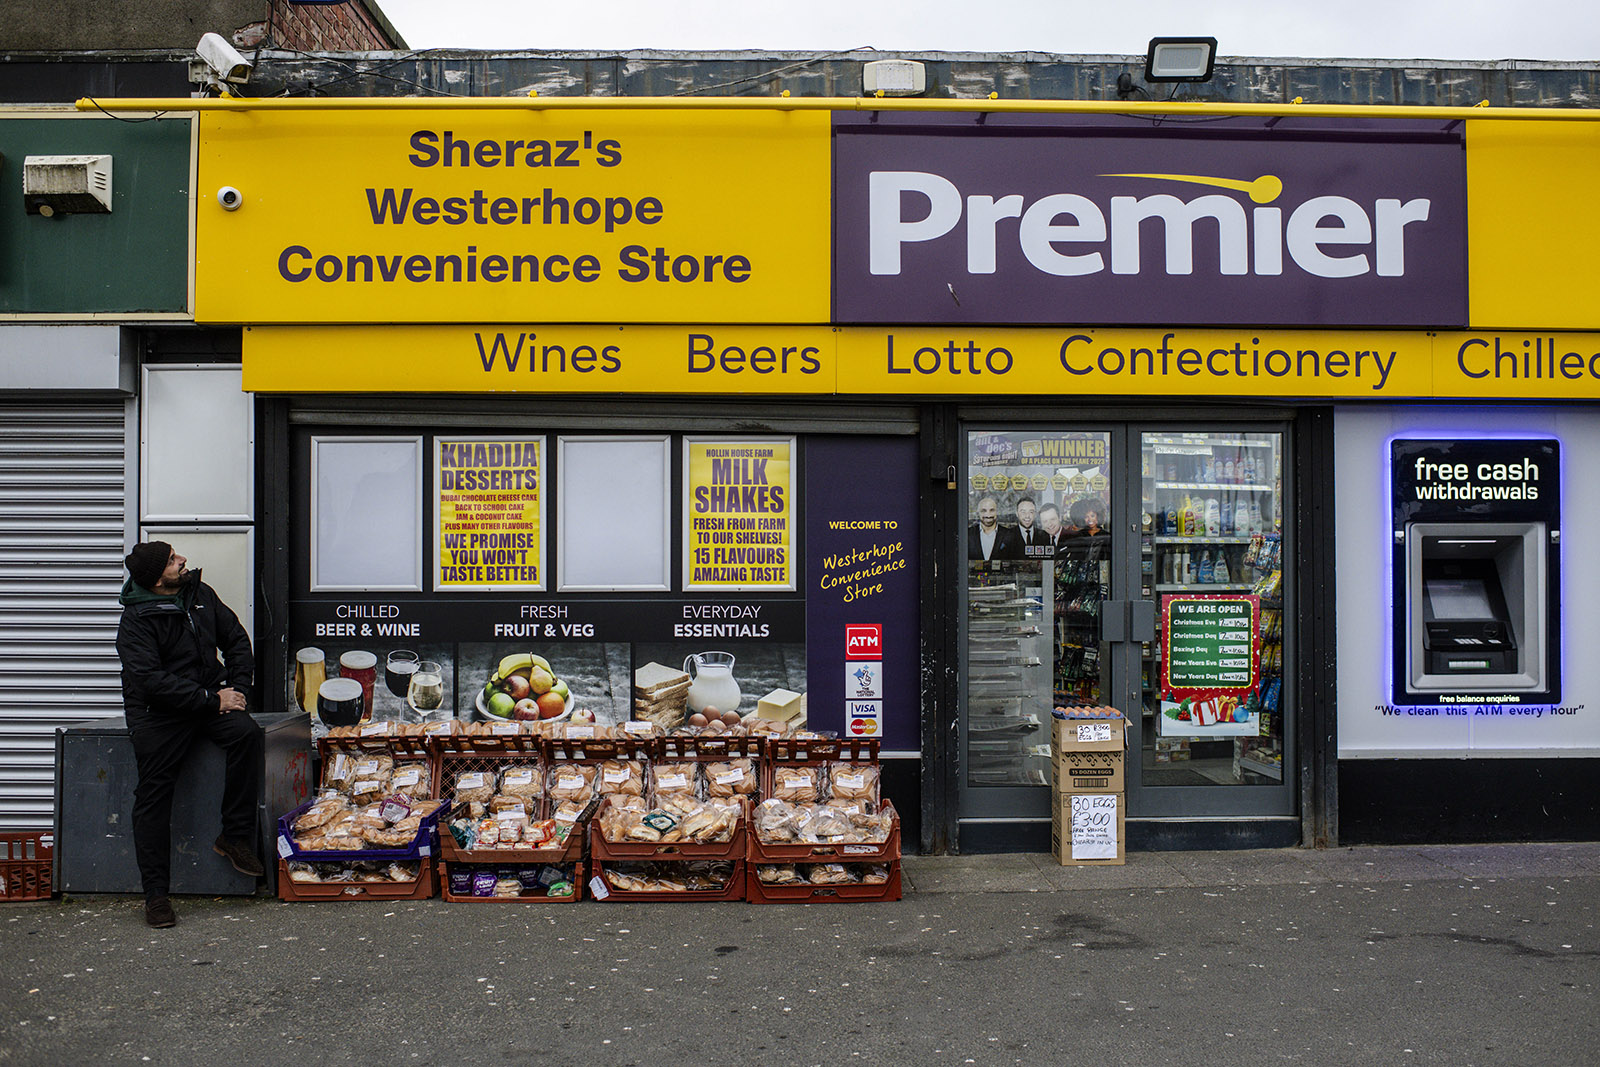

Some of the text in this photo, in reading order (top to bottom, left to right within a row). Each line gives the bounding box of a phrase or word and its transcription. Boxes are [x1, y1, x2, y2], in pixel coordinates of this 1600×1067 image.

[408, 130, 622, 168] Sheraz's
[366, 188, 664, 232] Westerhope
[869, 171, 1430, 278] Premier
[278, 245, 752, 283] Convenience Store
[474, 333, 622, 374] Wines
[688, 333, 821, 374] Beers
[887, 335, 1013, 375] Lotto
[1060, 333, 1397, 390] Confectionery
[706, 449, 773, 458] HOLLIN HOUSE FARM
[1024, 445, 1040, 456] TV
[1043, 440, 1105, 457] WINNER
[442, 444, 537, 468] KHADIJA
[712, 459, 768, 485] MILK
[1415, 457, 1539, 481] free cash
[442, 470, 536, 490] DESSERTS
[1416, 482, 1538, 500] withdrawals
[695, 486, 784, 513] SHAKES
[694, 518, 785, 530] FRESH FROM FARM
[829, 521, 898, 529] WELCOME TO
[445, 534, 534, 548] WE PROMISE
[697, 532, 782, 544] TO OUR SHELVES!
[450, 550, 528, 565] YOU WON'T
[694, 548, 785, 564] 15 FLAVOURS
[824, 542, 904, 570] Westerhope
[441, 566, 537, 581] TASTE BETTER
[694, 567, 785, 581] AMAZING TASTE
[820, 559, 906, 590] Convenience
[844, 583, 884, 602] Store
[336, 605, 400, 618] CHILLED
[520, 605, 567, 619] FRESH
[683, 605, 761, 619] EVERYDAY
[316, 623, 420, 636] BEER & WINE
[494, 624, 594, 637] FRUIT & VEG
[674, 624, 770, 637] ESSENTIALS
[849, 637, 878, 646] ATM
[1486, 695, 1520, 704] enquiries
[1408, 706, 1439, 716] clean
[1446, 706, 1467, 716] this
[1475, 706, 1503, 715] ATM
[1509, 706, 1544, 718] every
[1078, 725, 1090, 735] 30
[1073, 797, 1115, 811] 30 EGGS
